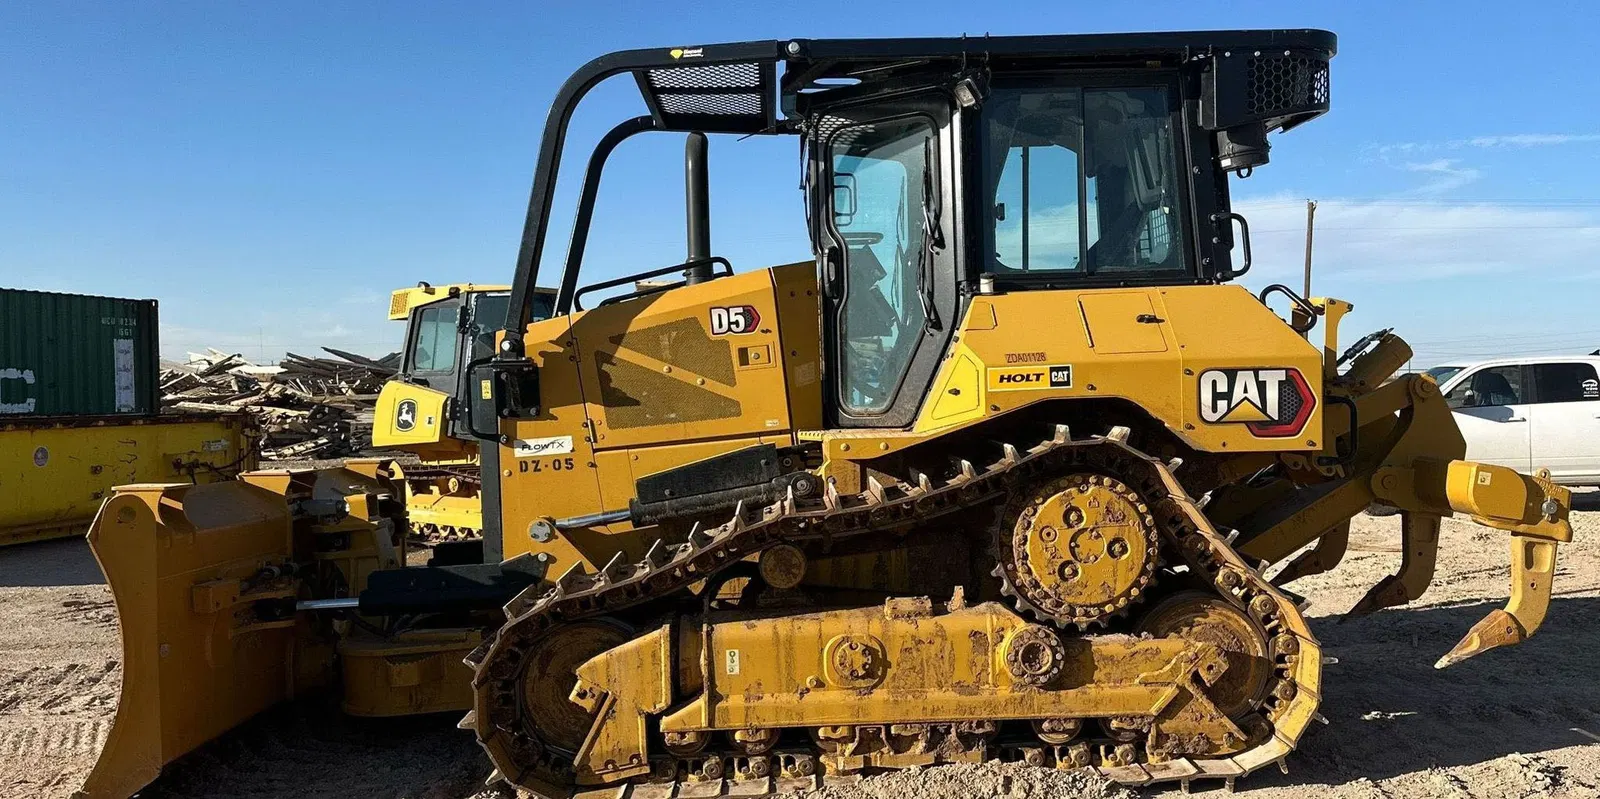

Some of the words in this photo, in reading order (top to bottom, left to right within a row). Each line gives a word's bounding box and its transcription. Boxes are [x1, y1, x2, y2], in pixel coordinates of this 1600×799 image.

[711, 306, 746, 334] D5
[999, 373, 1045, 383] HOLT
[1051, 371, 1069, 382] CAT
[1200, 370, 1286, 422] CAT
